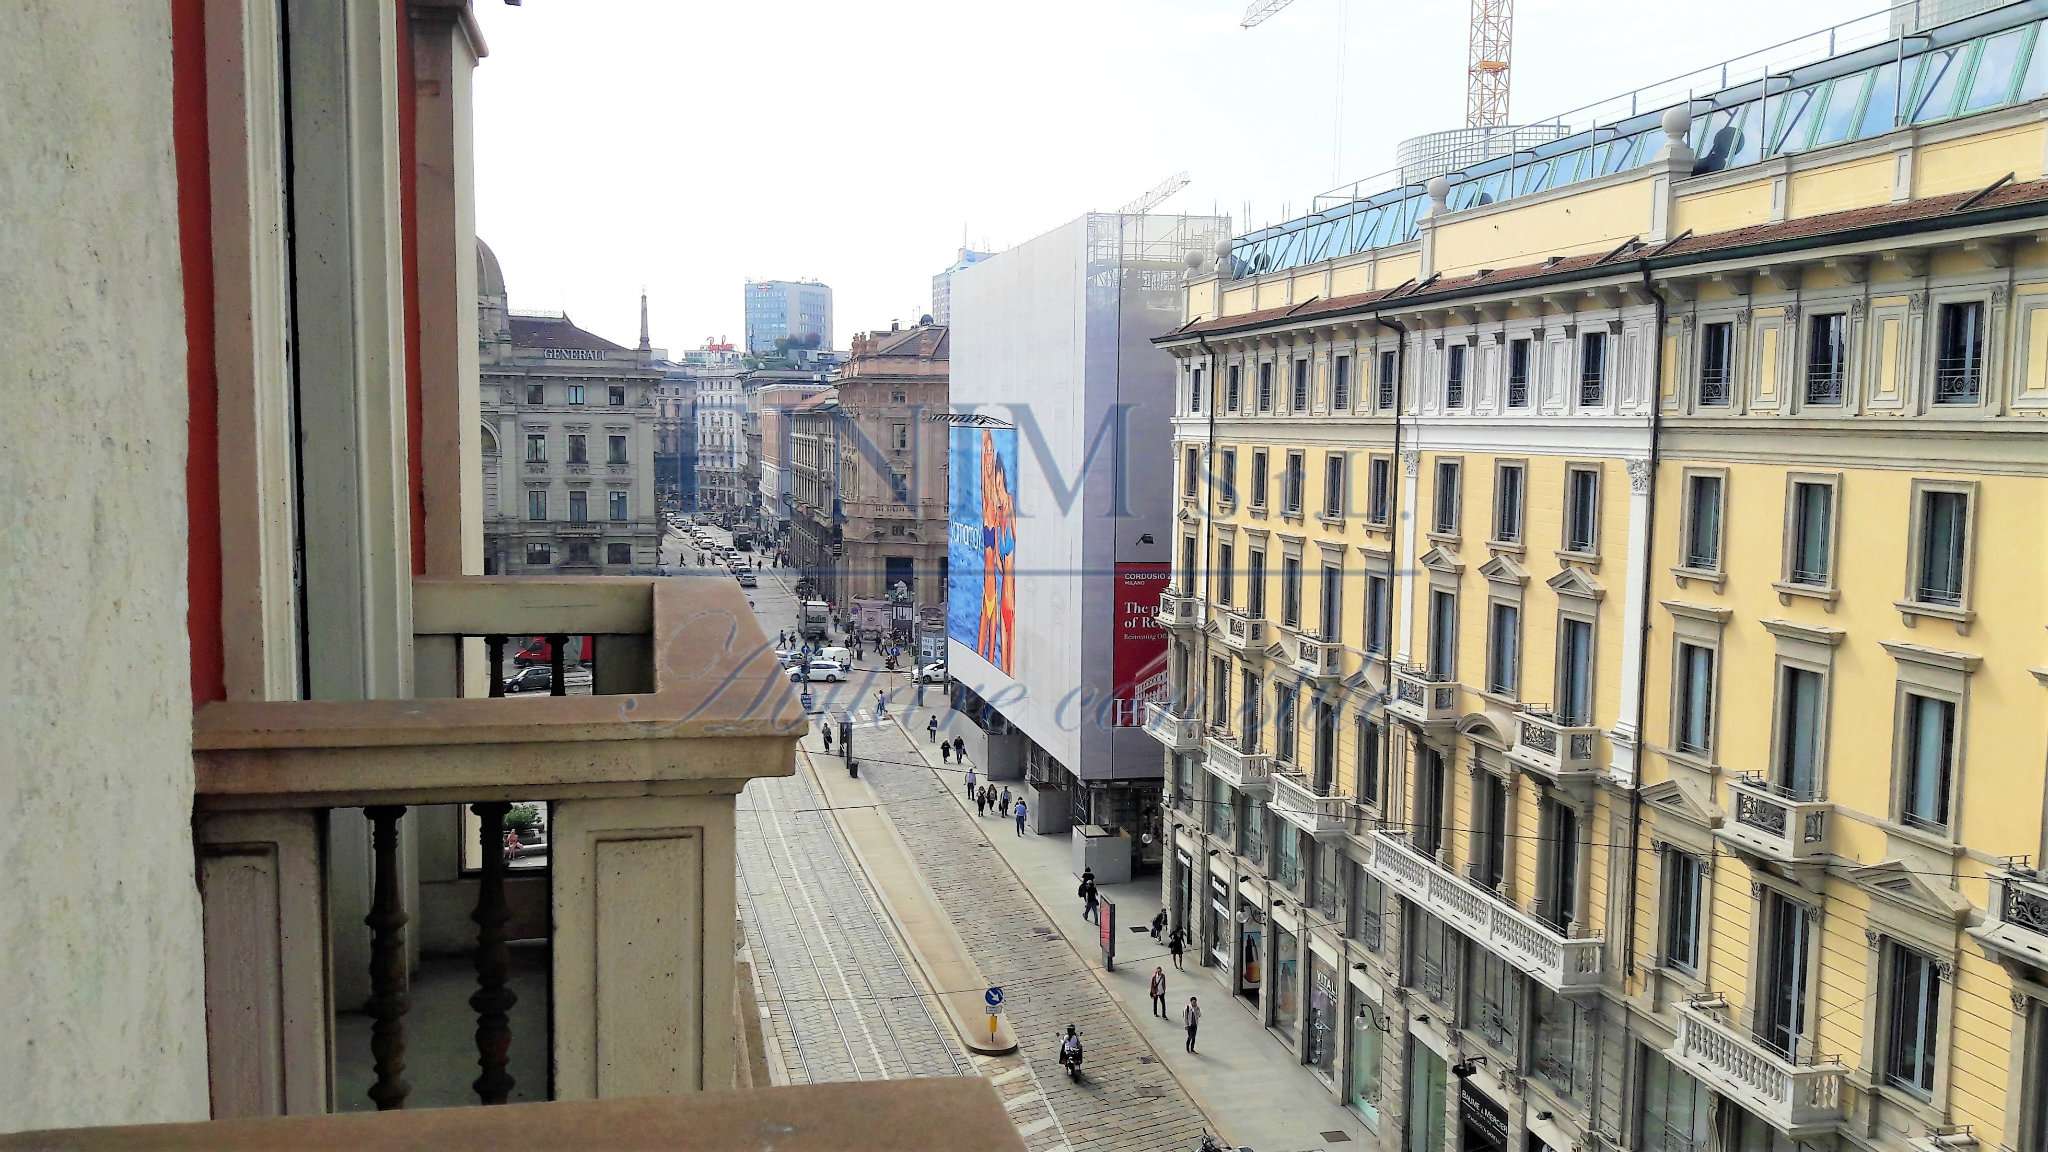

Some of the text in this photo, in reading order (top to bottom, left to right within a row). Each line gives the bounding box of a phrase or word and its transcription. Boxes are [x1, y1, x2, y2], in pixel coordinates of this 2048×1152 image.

[543, 347, 608, 361] GENERALI
[1124, 601, 1148, 614] The
[1124, 617, 1139, 629] of
[1461, 1089, 1480, 1111] BAUME
[1484, 1108, 1508, 1134] MERCIER
